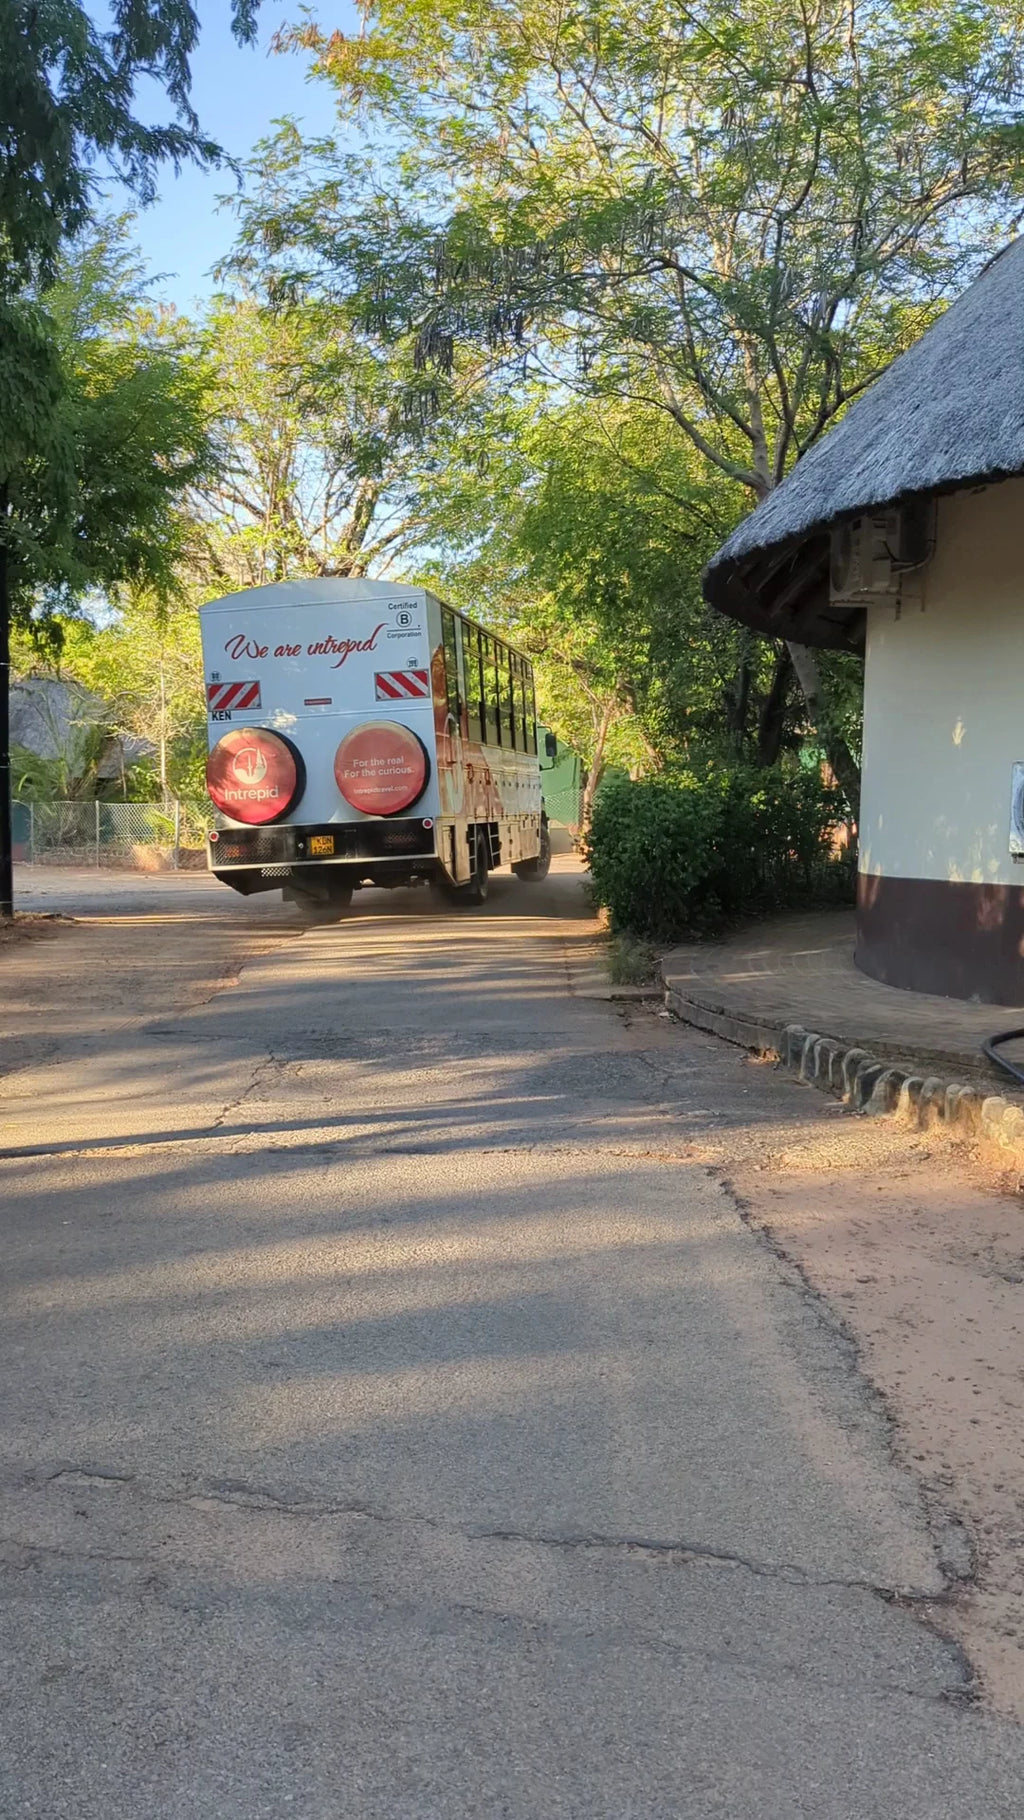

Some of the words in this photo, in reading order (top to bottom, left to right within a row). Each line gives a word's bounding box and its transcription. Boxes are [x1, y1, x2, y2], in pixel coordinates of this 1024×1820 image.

[388, 602, 418, 610] Certified
[400, 613, 409, 625] B
[386, 631, 422, 639] Corporation
[224, 634, 269, 660] We
[274, 644, 302, 657] are
[307, 622, 389, 669] intrepid
[211, 710, 231, 721] KEN
[353, 758, 368, 767] For
[370, 756, 385, 766] the
[387, 755, 404, 765] real
[344, 769, 360, 778] For
[361, 768, 376, 777] the
[378, 766, 415, 776] curious.
[224, 785, 279, 802] Intrepid
